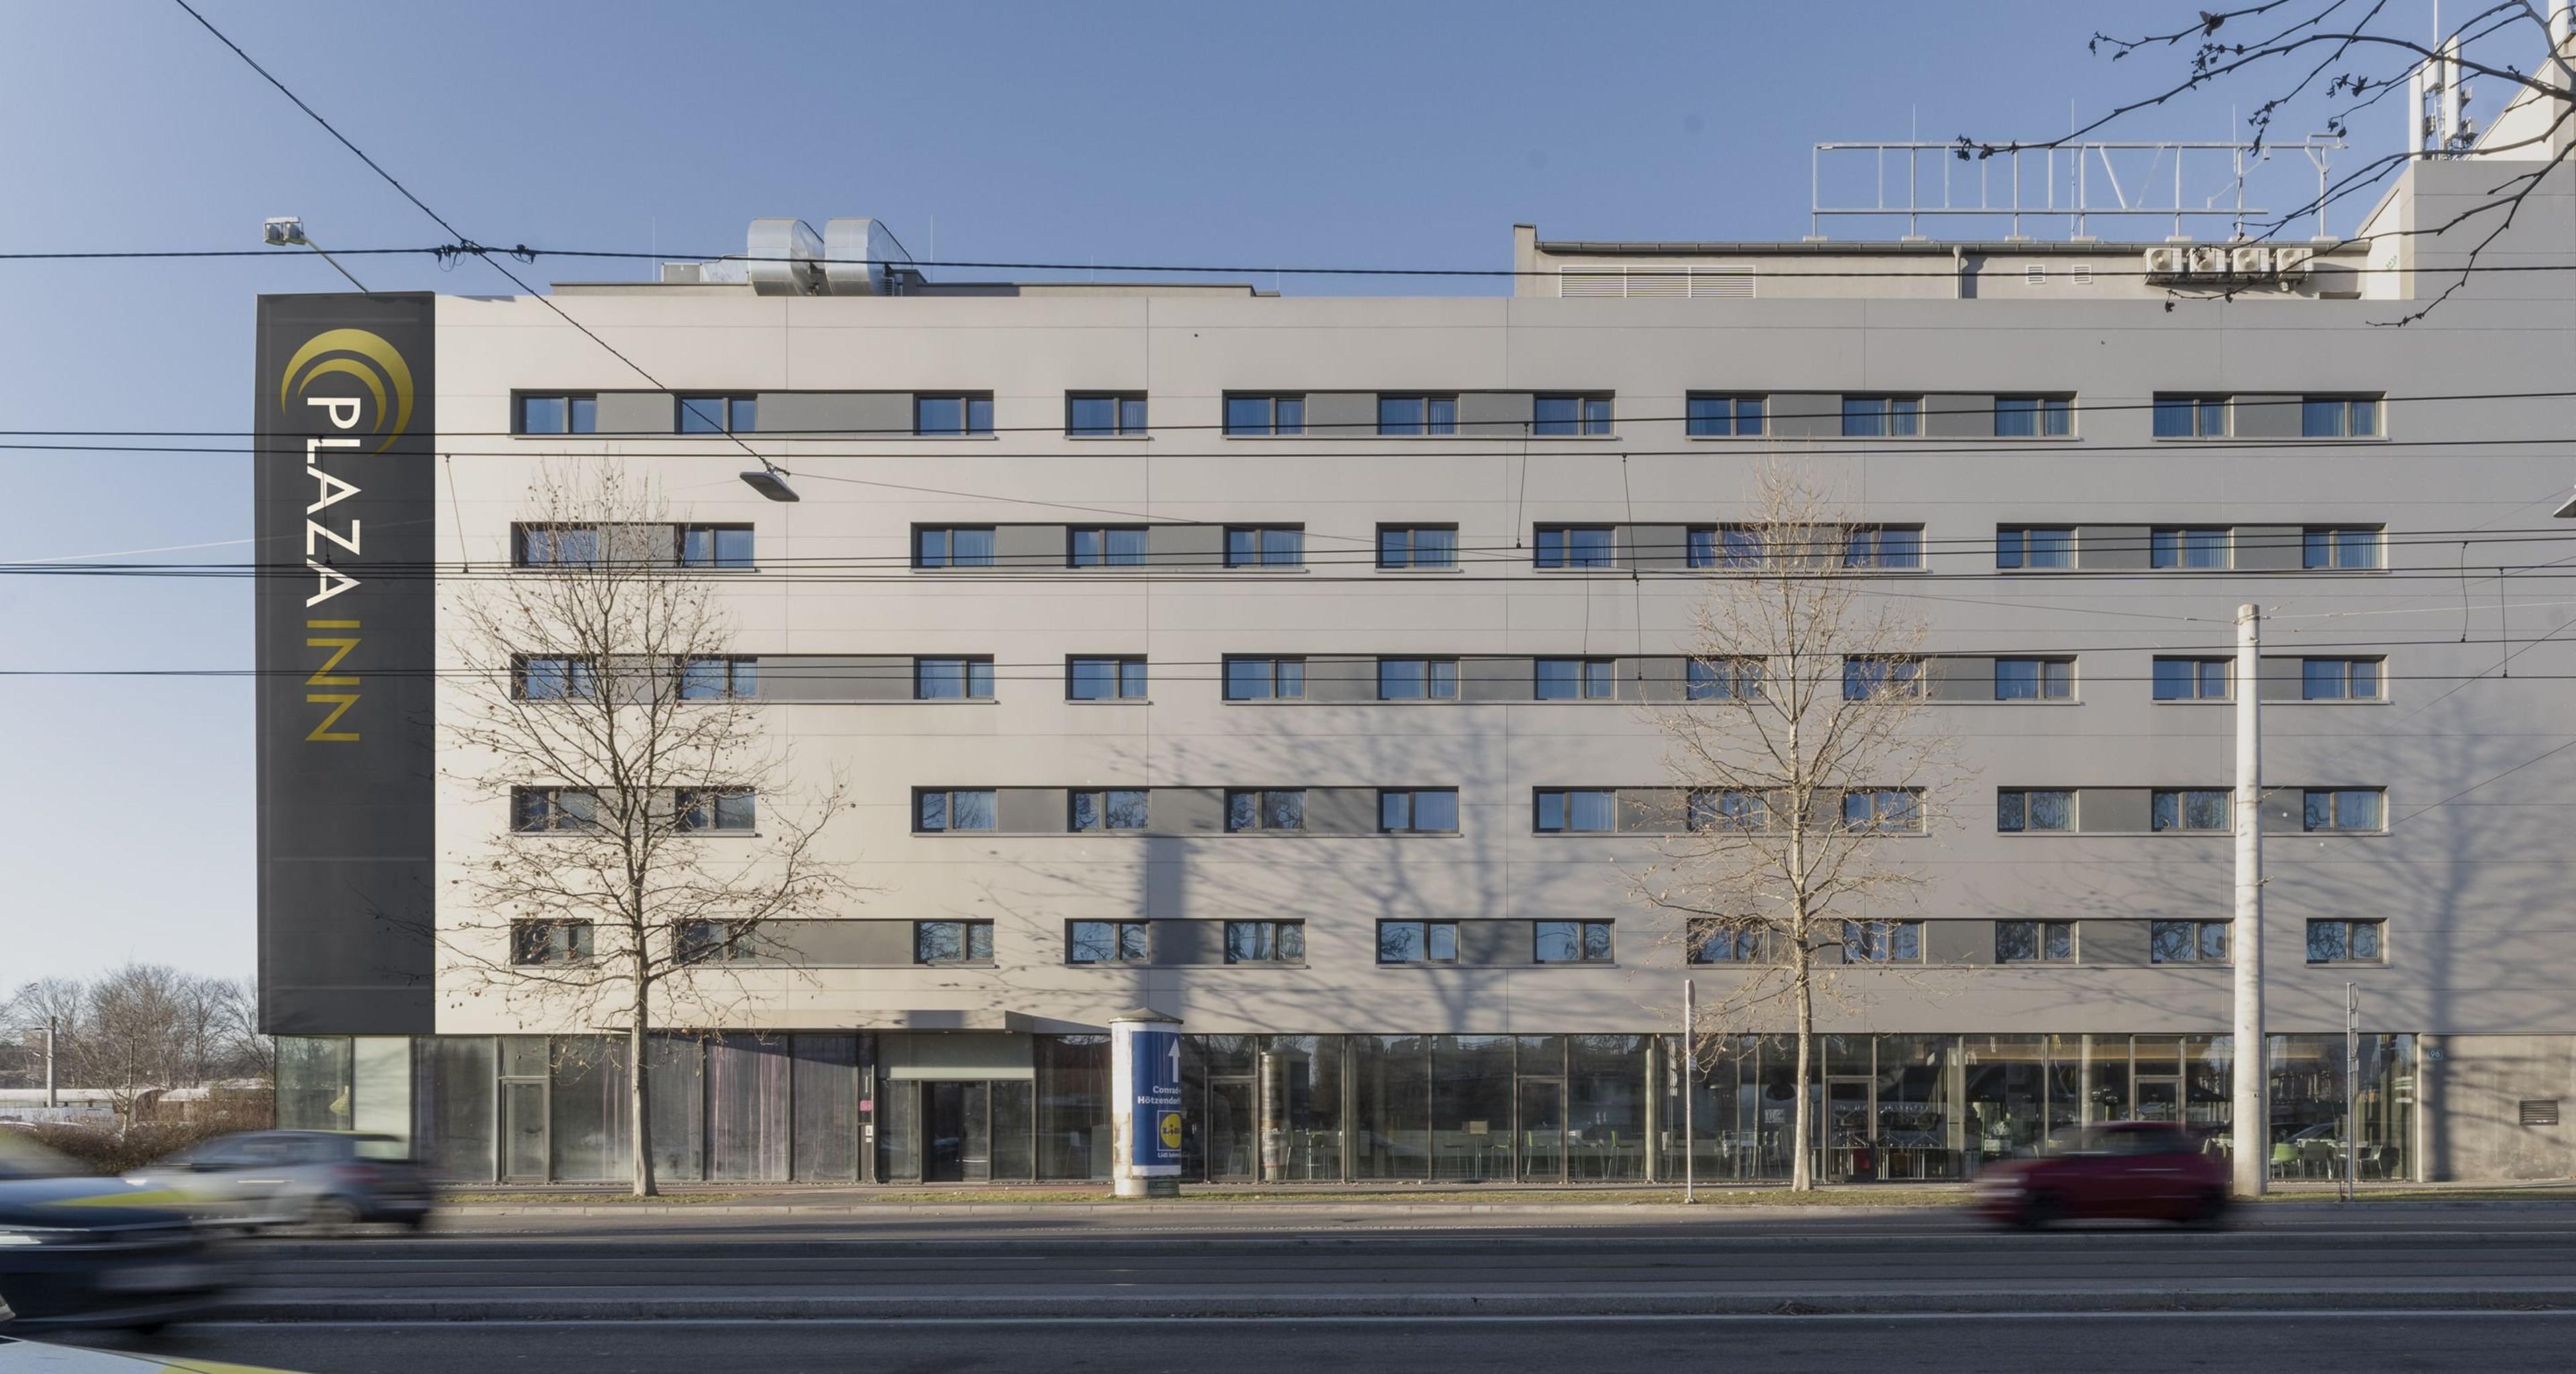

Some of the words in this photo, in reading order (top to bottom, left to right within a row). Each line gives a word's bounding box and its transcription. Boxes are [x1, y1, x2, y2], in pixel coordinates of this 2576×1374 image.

[307, 397, 362, 607] PLAZA
[305, 620, 362, 741] INN
[2430, 1049, 2440, 1058] 96
